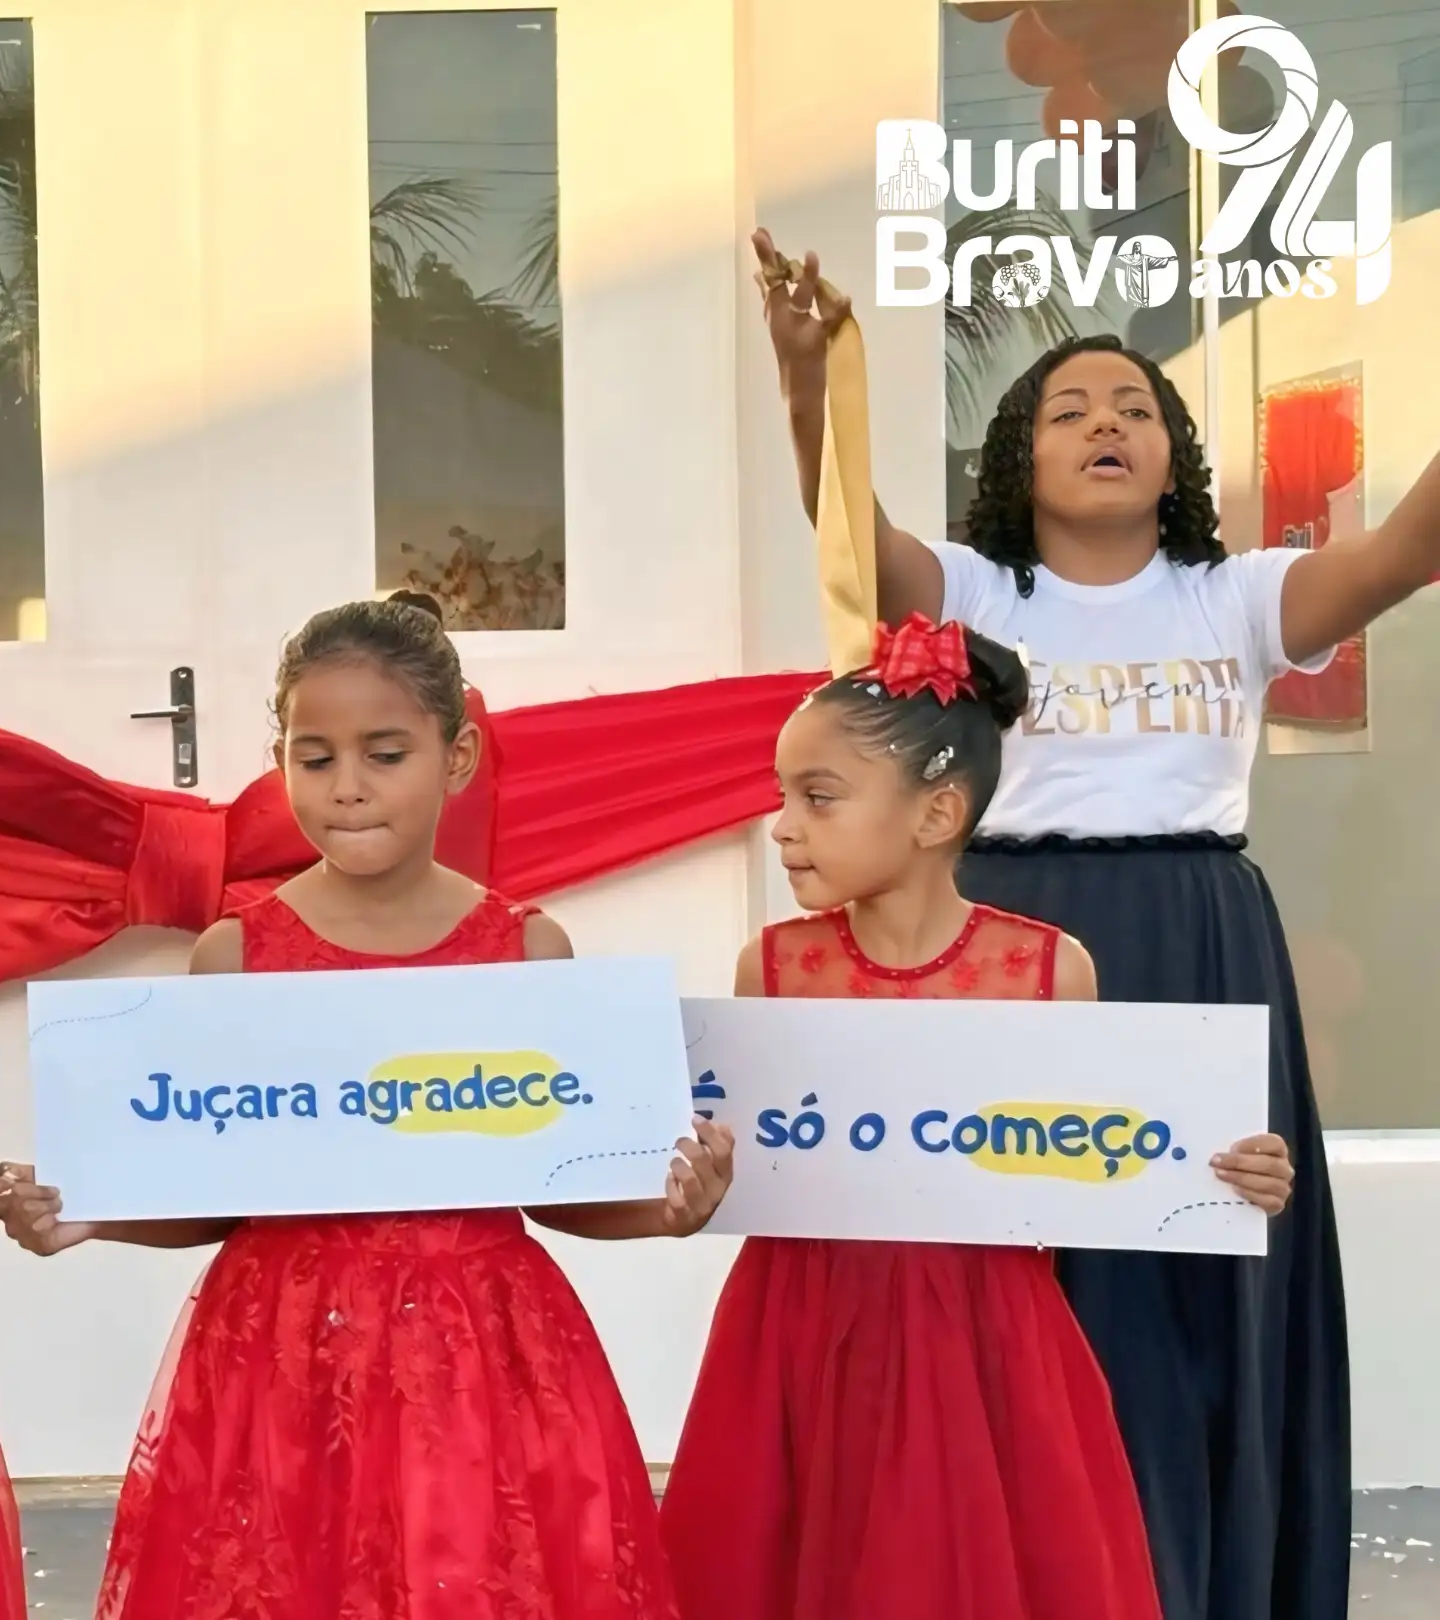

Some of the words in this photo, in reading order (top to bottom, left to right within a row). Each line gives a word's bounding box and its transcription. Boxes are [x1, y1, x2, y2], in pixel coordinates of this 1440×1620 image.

[1021, 657, 1245, 738] ESPERTA
[130, 1072, 319, 1135] Juçara
[339, 1063, 594, 1125] agradece.
[755, 1091, 826, 1150] só
[849, 1112, 886, 1152] o
[910, 1109, 1187, 1178] começo.
